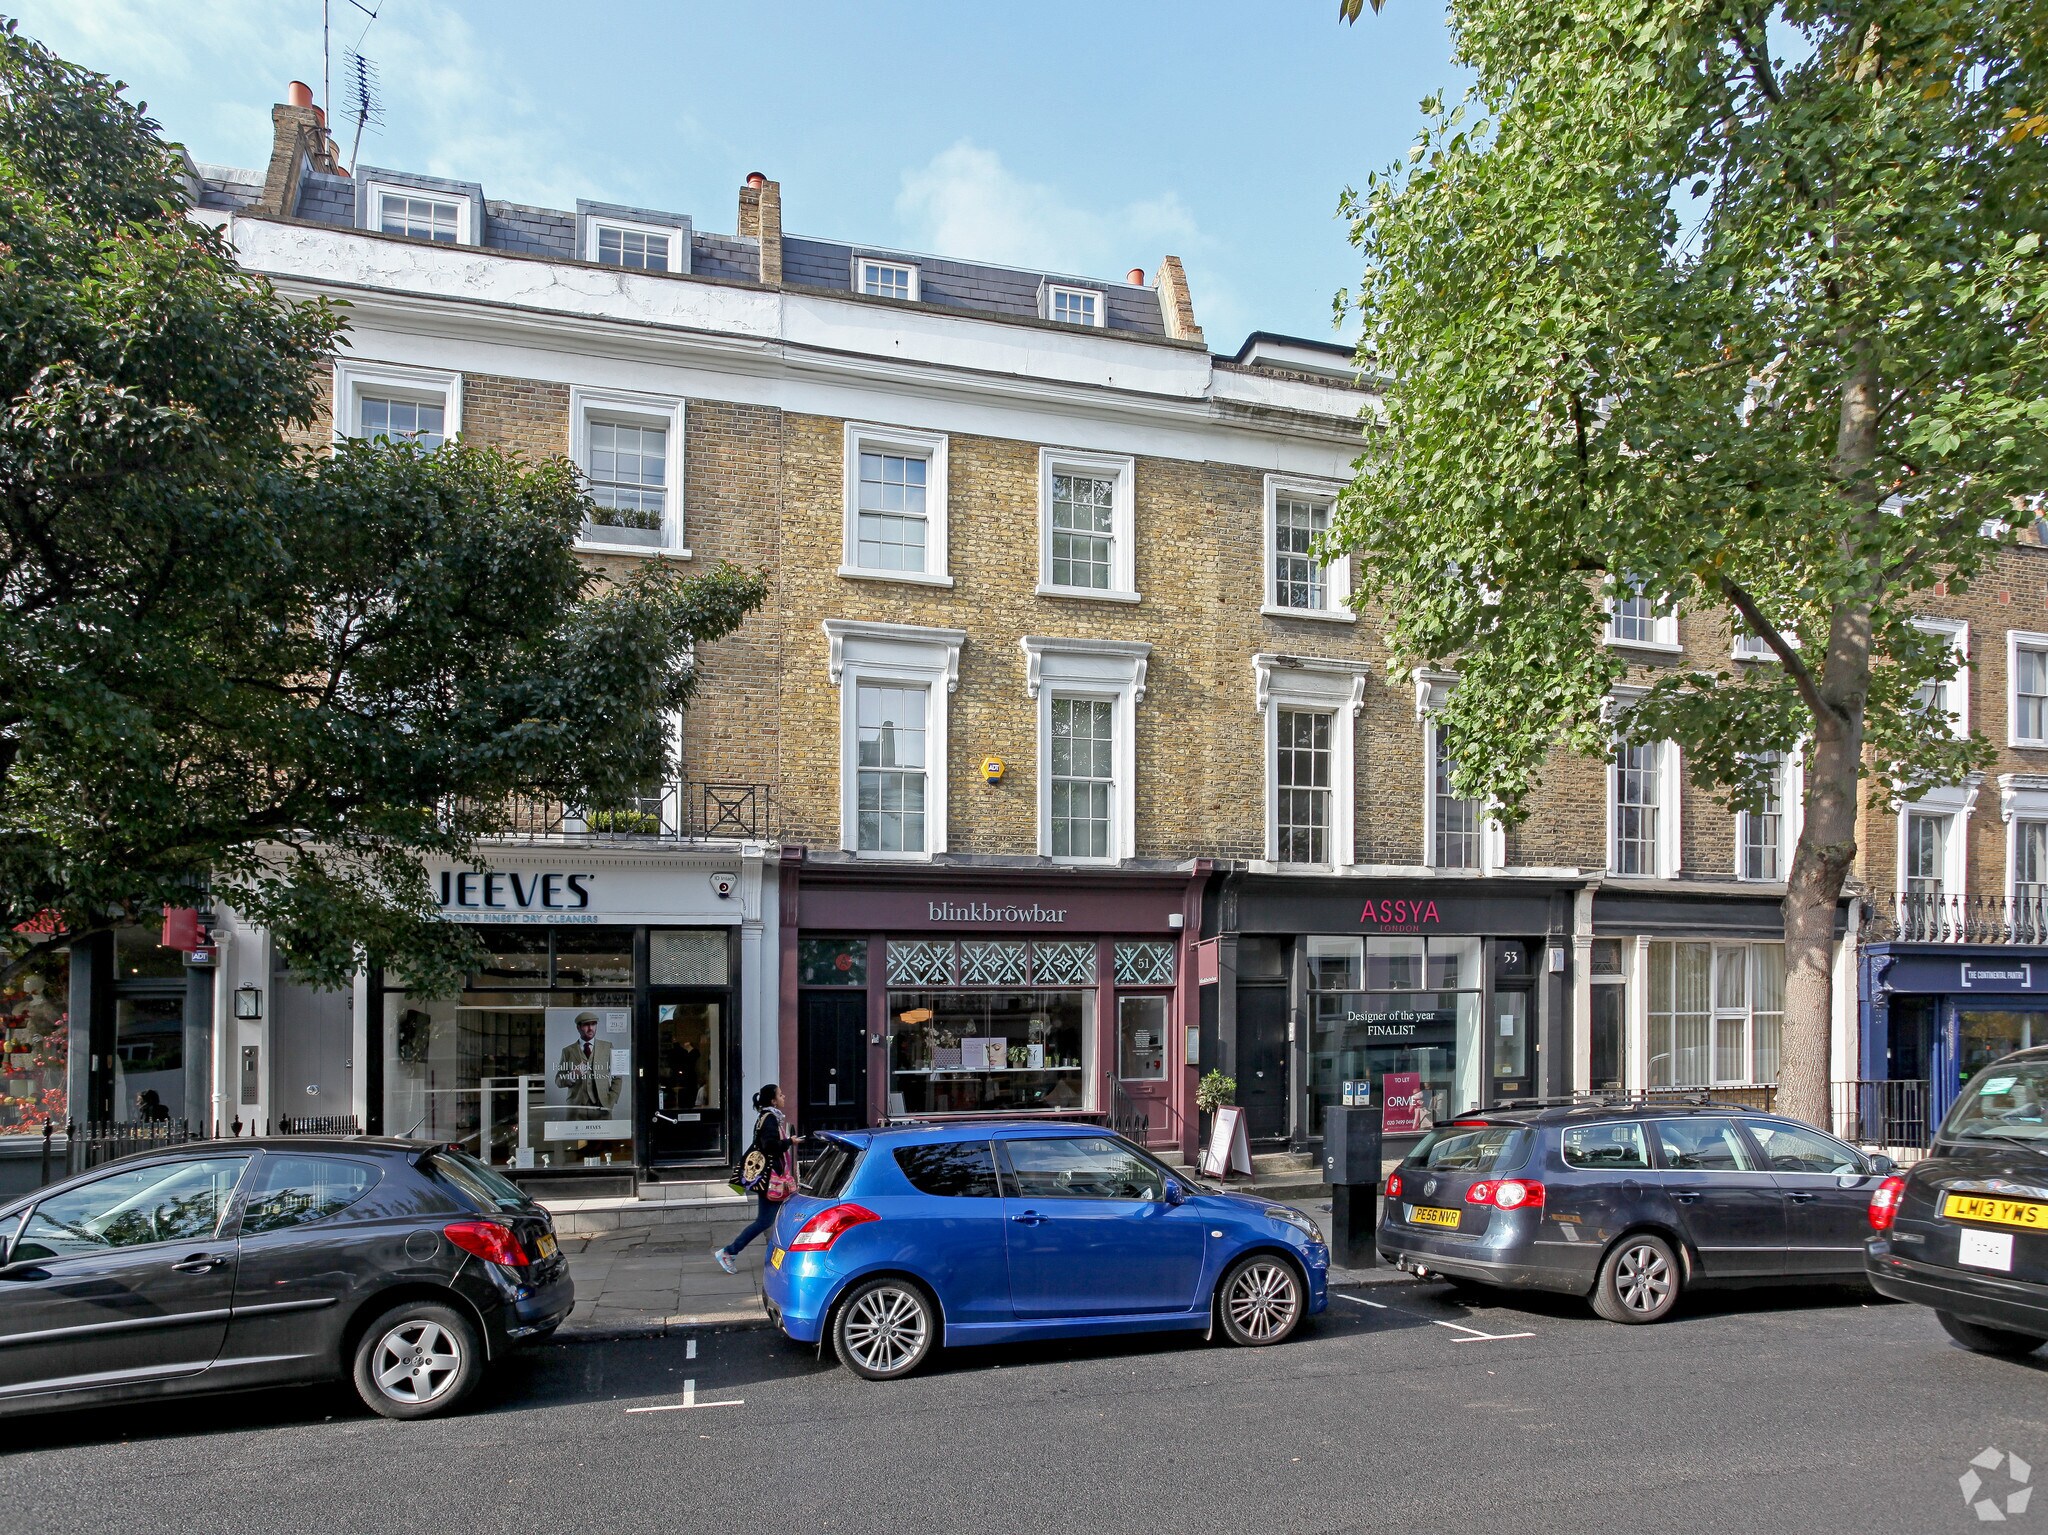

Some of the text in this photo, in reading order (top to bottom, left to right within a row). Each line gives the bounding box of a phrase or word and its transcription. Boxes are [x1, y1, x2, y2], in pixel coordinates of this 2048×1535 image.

[433, 872, 588, 908] JEEVES
[928, 901, 1067, 923] blinkbrõwbar
[1360, 900, 1440, 923] ASSYA
[483, 913, 518, 923] FINEST
[522, 914, 543, 923] DRY
[546, 915, 598, 924] CLEANERS
[192, 952, 208, 960] ADT
[1504, 951, 1517, 963] 53
[1138, 958, 1149, 969] 51
[1968, 971, 1977, 979] THE
[1977, 971, 2007, 979] CONTINENTAL
[1348, 1011, 1435, 1023] Designer of the year
[1367, 1025, 1416, 1036] FINALIST
[571, 1061, 592, 1071] back
[595, 1061, 604, 1071] in
[560, 1070, 579, 1080] with
[1345, 1082, 1351, 1095] P
[1358, 1083, 1367, 1095] P
[1387, 1096, 1417, 1107] ORME
[1416, 1208, 1458, 1224] PE56 NVR
[2003, 1203, 2039, 1223] YWS
